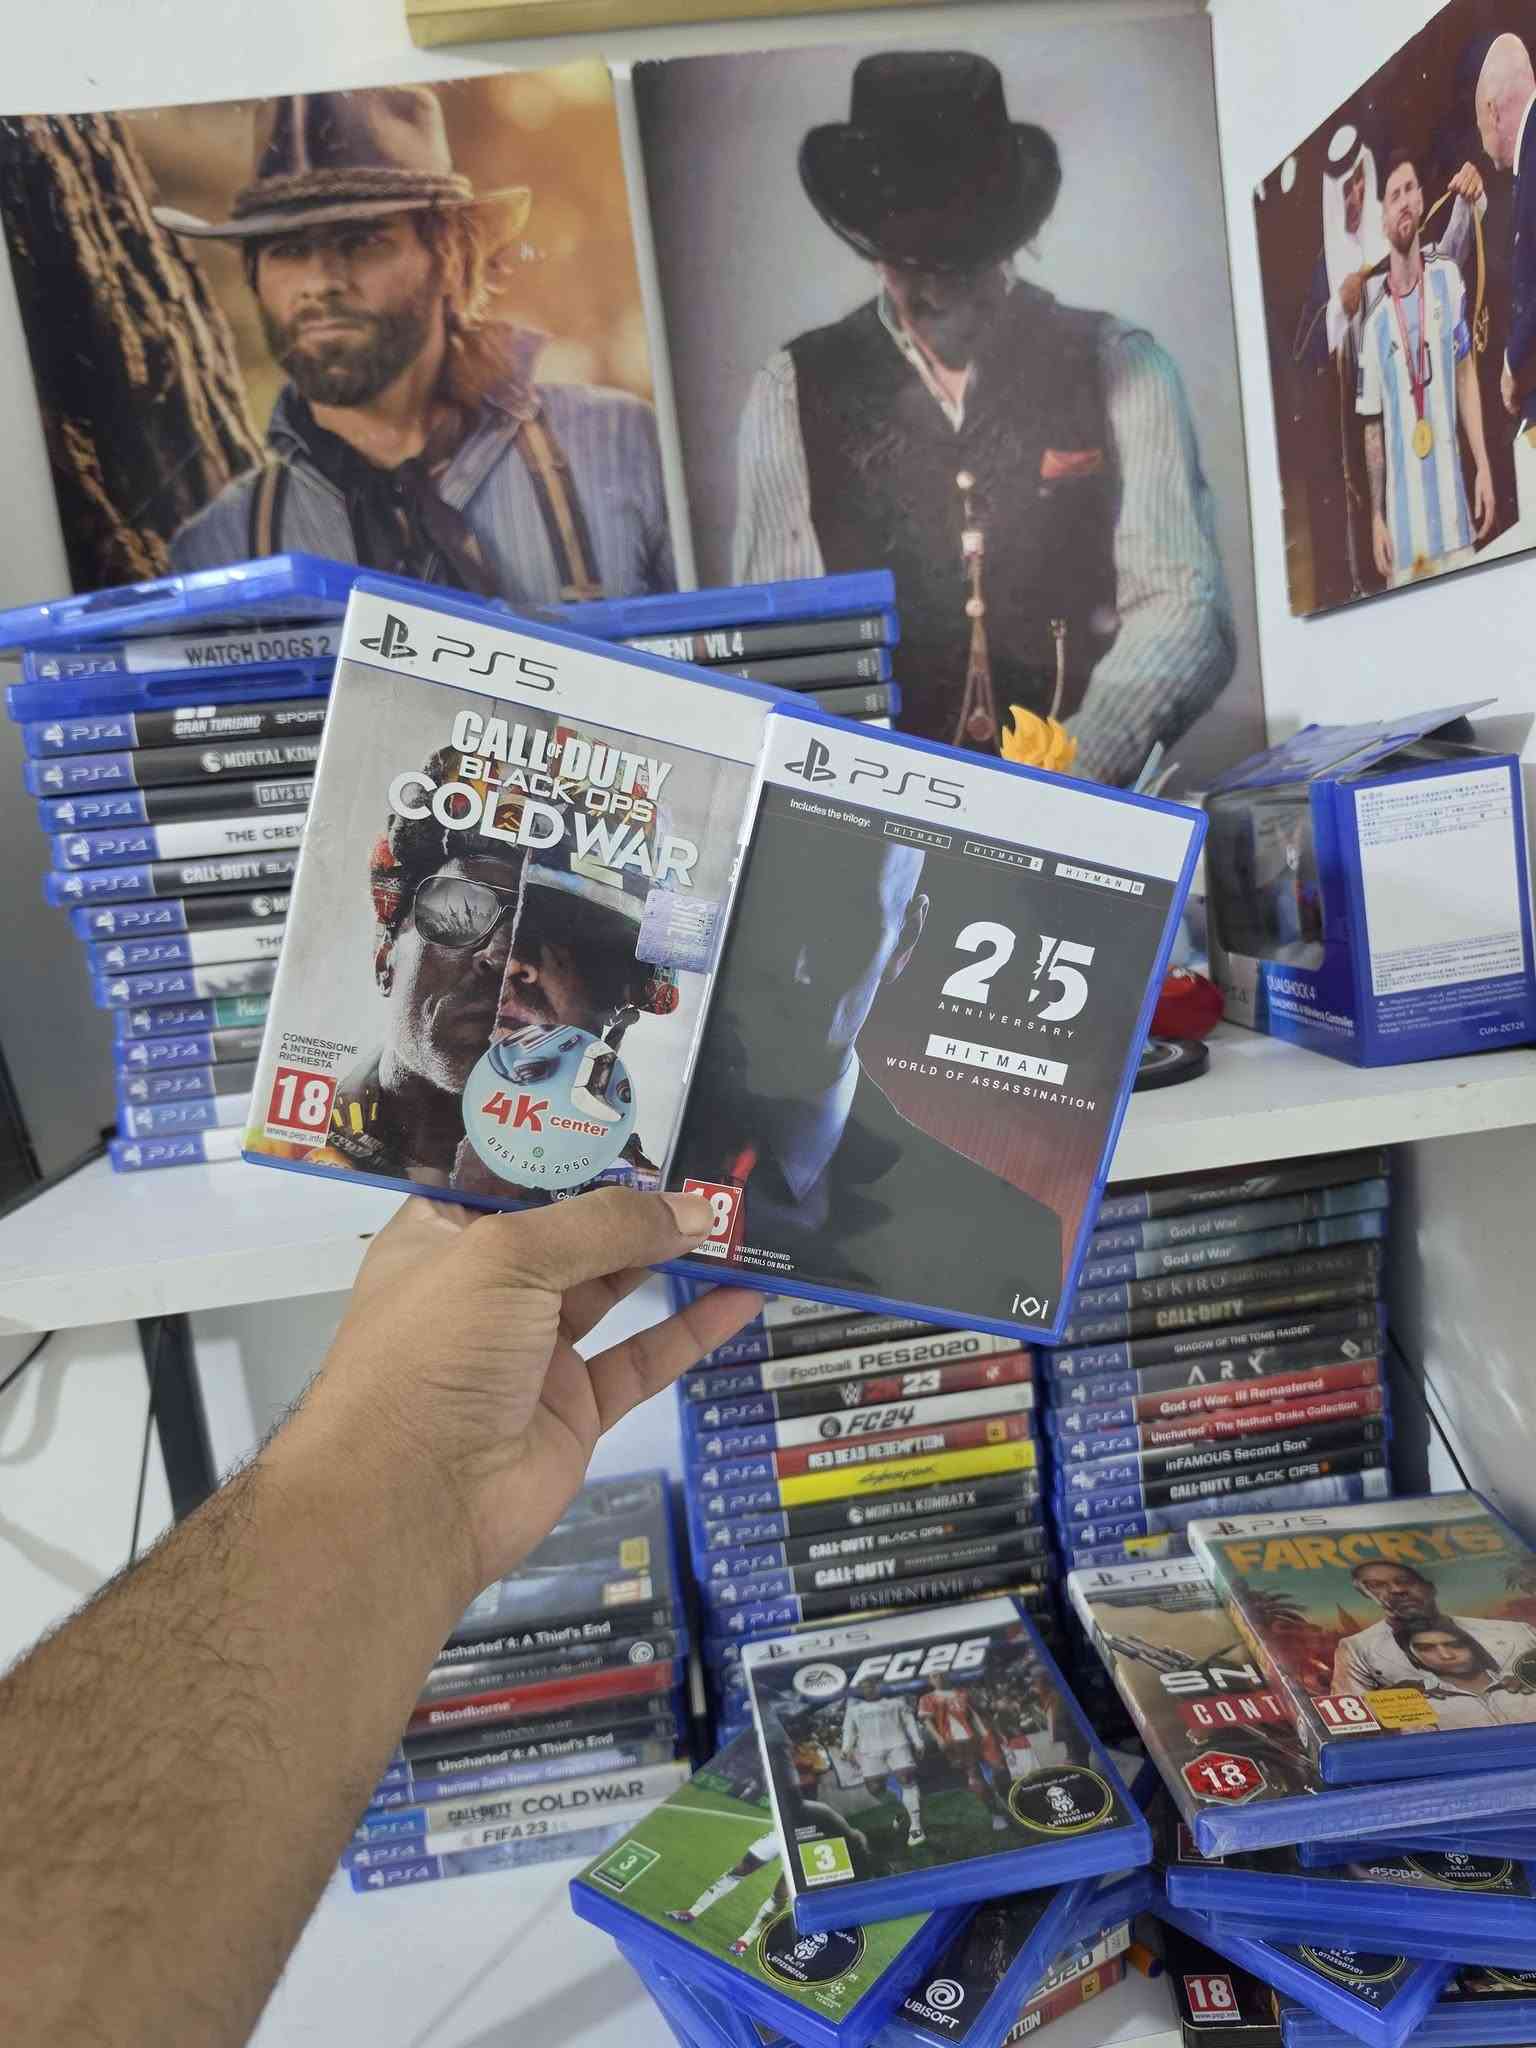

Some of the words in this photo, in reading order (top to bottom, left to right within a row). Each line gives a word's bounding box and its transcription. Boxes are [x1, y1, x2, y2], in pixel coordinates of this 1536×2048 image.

[185, 643, 254, 665] WATCH
[258, 637, 314, 661] DOGS
[317, 635, 332, 656] 2
[432, 635, 560, 693] PS5
[174, 719, 207, 735] GRAN
[224, 749, 285, 769] MORTAL
[451, 710, 551, 773] CALL
[547, 742, 564, 759] OF
[560, 737, 673, 801] DUTY
[459, 754, 577, 805] BLACK
[584, 787, 658, 823] OPS
[848, 758, 965, 809] PS5
[789, 797, 828, 818] Includes
[827, 807, 842, 819] the
[225, 830, 257, 843] THE
[388, 771, 567, 849] COLD
[574, 811, 699, 888] WAR
[892, 825, 944, 845] HITMAN
[973, 846, 1025, 866] HITMAN
[182, 865, 217, 884] CALL
[221, 862, 261, 880] DUTY
[1064, 868, 1123, 889] HITMAN
[941, 921, 1096, 1022] 25
[938, 1001, 1075, 1040] ANNIVERSARY
[281, 1042, 288, 1051] A
[290, 1044, 341, 1061] INTERNET
[282, 1032, 358, 1055] CONNESSIONE
[279, 1051, 332, 1069] RICHIESTA
[945, 1042, 1049, 1077] HITMAN
[886, 1056, 938, 1076] WORLD
[945, 1069, 964, 1082] OF
[971, 1075, 1097, 1112] ASSASSINATION
[279, 1074, 330, 1126] 18
[482, 1091, 549, 1133] 4K
[550, 1115, 609, 1137] center
[487, 1136, 516, 1163] 0751
[521, 1159, 546, 1174] 363
[554, 1157, 590, 1175] 2950
[1170, 1225, 1197, 1239] God
[1199, 1222, 1212, 1233] of
[1215, 1218, 1240, 1232] War
[733, 1254, 744, 1262] SEE
[744, 1256, 767, 1267] DETAILS
[734, 1245, 762, 1256] INTERNET
[1163, 1253, 1190, 1268] God
[1191, 1250, 1204, 1263] of
[1206, 1248, 1232, 1261] War
[1156, 1306, 1196, 1328] CALL
[1199, 1299, 1244, 1320] DUTY
[858, 1338, 981, 1370] PES2020
[1174, 1340, 1214, 1354] SHADOW
[1216, 1337, 1229, 1348] OF
[1231, 1334, 1248, 1346] THE
[1249, 1330, 1276, 1343] TOMB
[1160, 1400, 1187, 1414] God
[1189, 1397, 1202, 1410] of
[1250, 1377, 1324, 1401] Remastered
[847, 1407, 915, 1434] FC24
[1215, 1420, 1234, 1433] The
[1236, 1414, 1272, 1430] Nathan
[1274, 1410, 1305, 1424] Drake
[1307, 1401, 1358, 1417] Collection
[1166, 1450, 1232, 1472] inFAMOUS
[1234, 1443, 1281, 1460] Second
[1283, 1439, 1307, 1452] Son
[1170, 1482, 1199, 1500] CALL
[1203, 1476, 1233, 1494] DUTY
[1235, 1470, 1287, 1488] BLACK
[1289, 1463, 1320, 1477] OPS
[864, 1501, 914, 1520] MORTAL
[916, 1495, 965, 1512] KOMBAT
[1252, 1514, 1327, 1531] PS5
[809, 1541, 839, 1559] CALL
[842, 1535, 874, 1552] DUTY
[877, 1531, 918, 1545] BLACK
[815, 1565, 853, 1587] CALL
[855, 1558, 896, 1578] DUTY
[1128, 1562, 1205, 1582] PS5
[523, 1632, 535, 1646] A
[536, 1627, 582, 1643] Thief's
[583, 1621, 611, 1635] End
[798, 1630, 870, 1653] PS5
[850, 1636, 992, 1688] FC26
[429, 1702, 513, 1724] Bloodborne
[1317, 1697, 1368, 1724] 18
[436, 1752, 508, 1773] Uncharted
[527, 1744, 539, 1757] A
[541, 1739, 585, 1756] Thief's
[586, 1732, 614, 1747] End
[1200, 1763, 1248, 1791] 18
[522, 1789, 590, 1817] COLD
[591, 1780, 645, 1801] WAR
[482, 1825, 524, 1844] FIFA
[527, 1820, 549, 1836] 23
[619, 1855, 638, 1871] 3
[813, 1843, 838, 1871] 3
[1368, 1866, 1425, 1881] ASOBO
[1189, 1979, 1232, 2008] 18
[903, 1998, 960, 2030] UBISOFT
